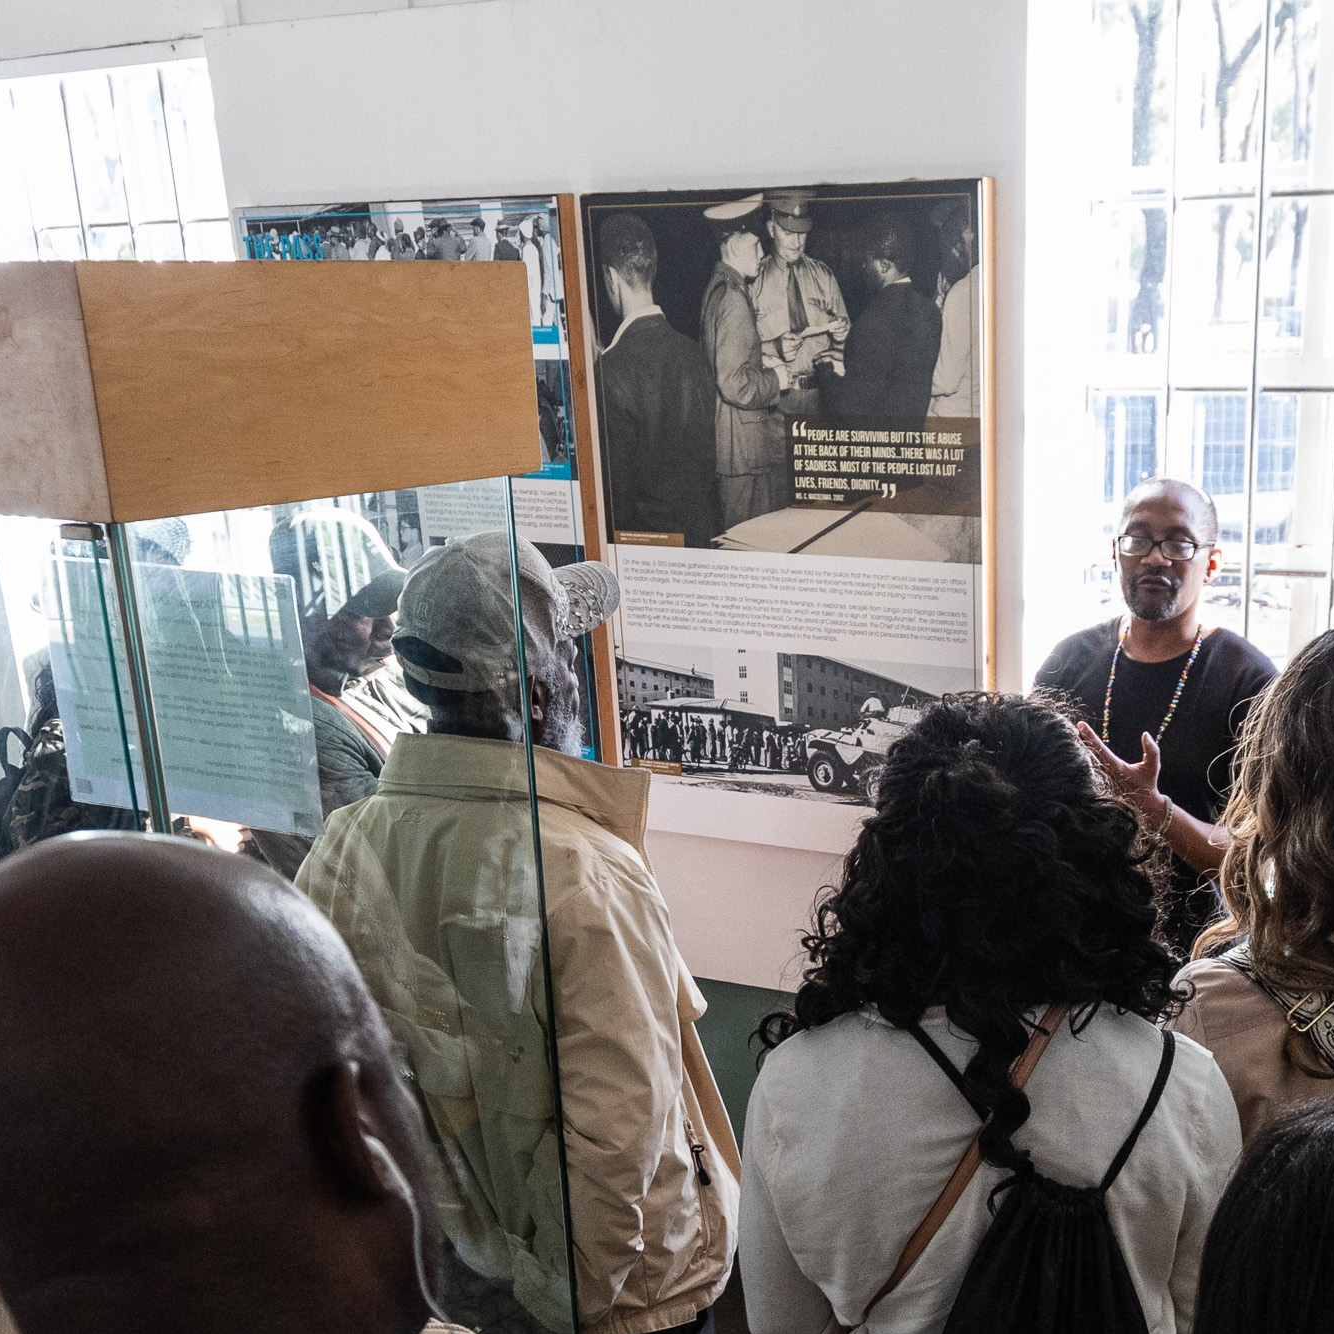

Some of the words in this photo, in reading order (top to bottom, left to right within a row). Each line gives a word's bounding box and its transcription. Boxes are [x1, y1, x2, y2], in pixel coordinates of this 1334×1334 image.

[242, 234, 273, 260] THE
[280, 233, 324, 260] PASS
[835, 430, 849, 441] ARE
[850, 430, 889, 442] SURVIVING
[890, 431, 905, 443] BUT
[906, 432, 920, 443] IT'S
[921, 432, 936, 444] THE
[936, 433, 962, 445] ABUSE
[793, 444, 802, 455] AT
[803, 444, 817, 455] THE
[818, 444, 838, 456] BACK
[838, 445, 848, 456] OF
[849, 445, 871, 457] THEIR
[924, 448, 942, 459] WAS
[942, 448, 949, 459] A
[950, 449, 964, 460] LOT
[794, 459, 803, 470] OF
[804, 459, 838, 472] SADNESS.
[839, 460, 860, 472] MOST
[860, 461, 871, 473] OF
[872, 462, 886, 473] THE
[887, 462, 914, 474] PEOPLE
[915, 463, 934, 475] LOST
[935, 464, 941, 475] A
[942, 464, 956, 476] LOT
[794, 476, 817, 488] LIVES,
[817, 477, 850, 489] FRIENDS,
